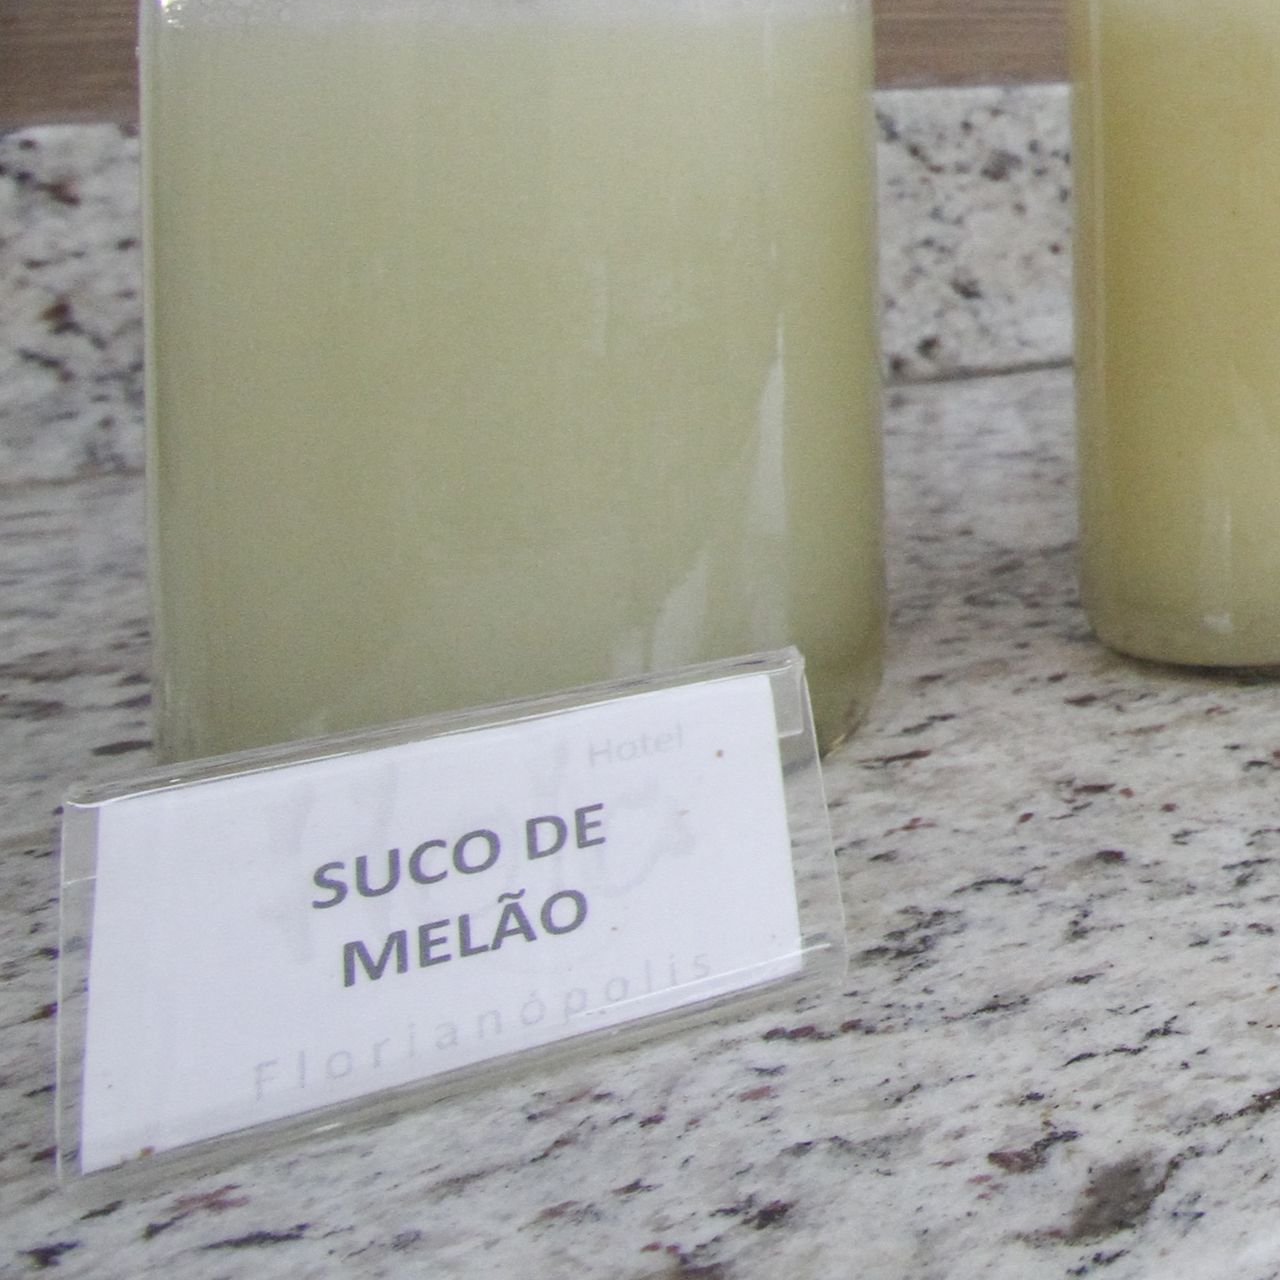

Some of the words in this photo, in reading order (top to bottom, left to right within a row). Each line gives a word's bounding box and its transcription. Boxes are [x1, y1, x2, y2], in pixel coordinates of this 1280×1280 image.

[588, 721, 683, 767] Hotel
[311, 827, 502, 910] SUCO
[525, 802, 606, 861] DE
[342, 888, 588, 988] MELÃO
[252, 950, 714, 1103] Florianópolis
